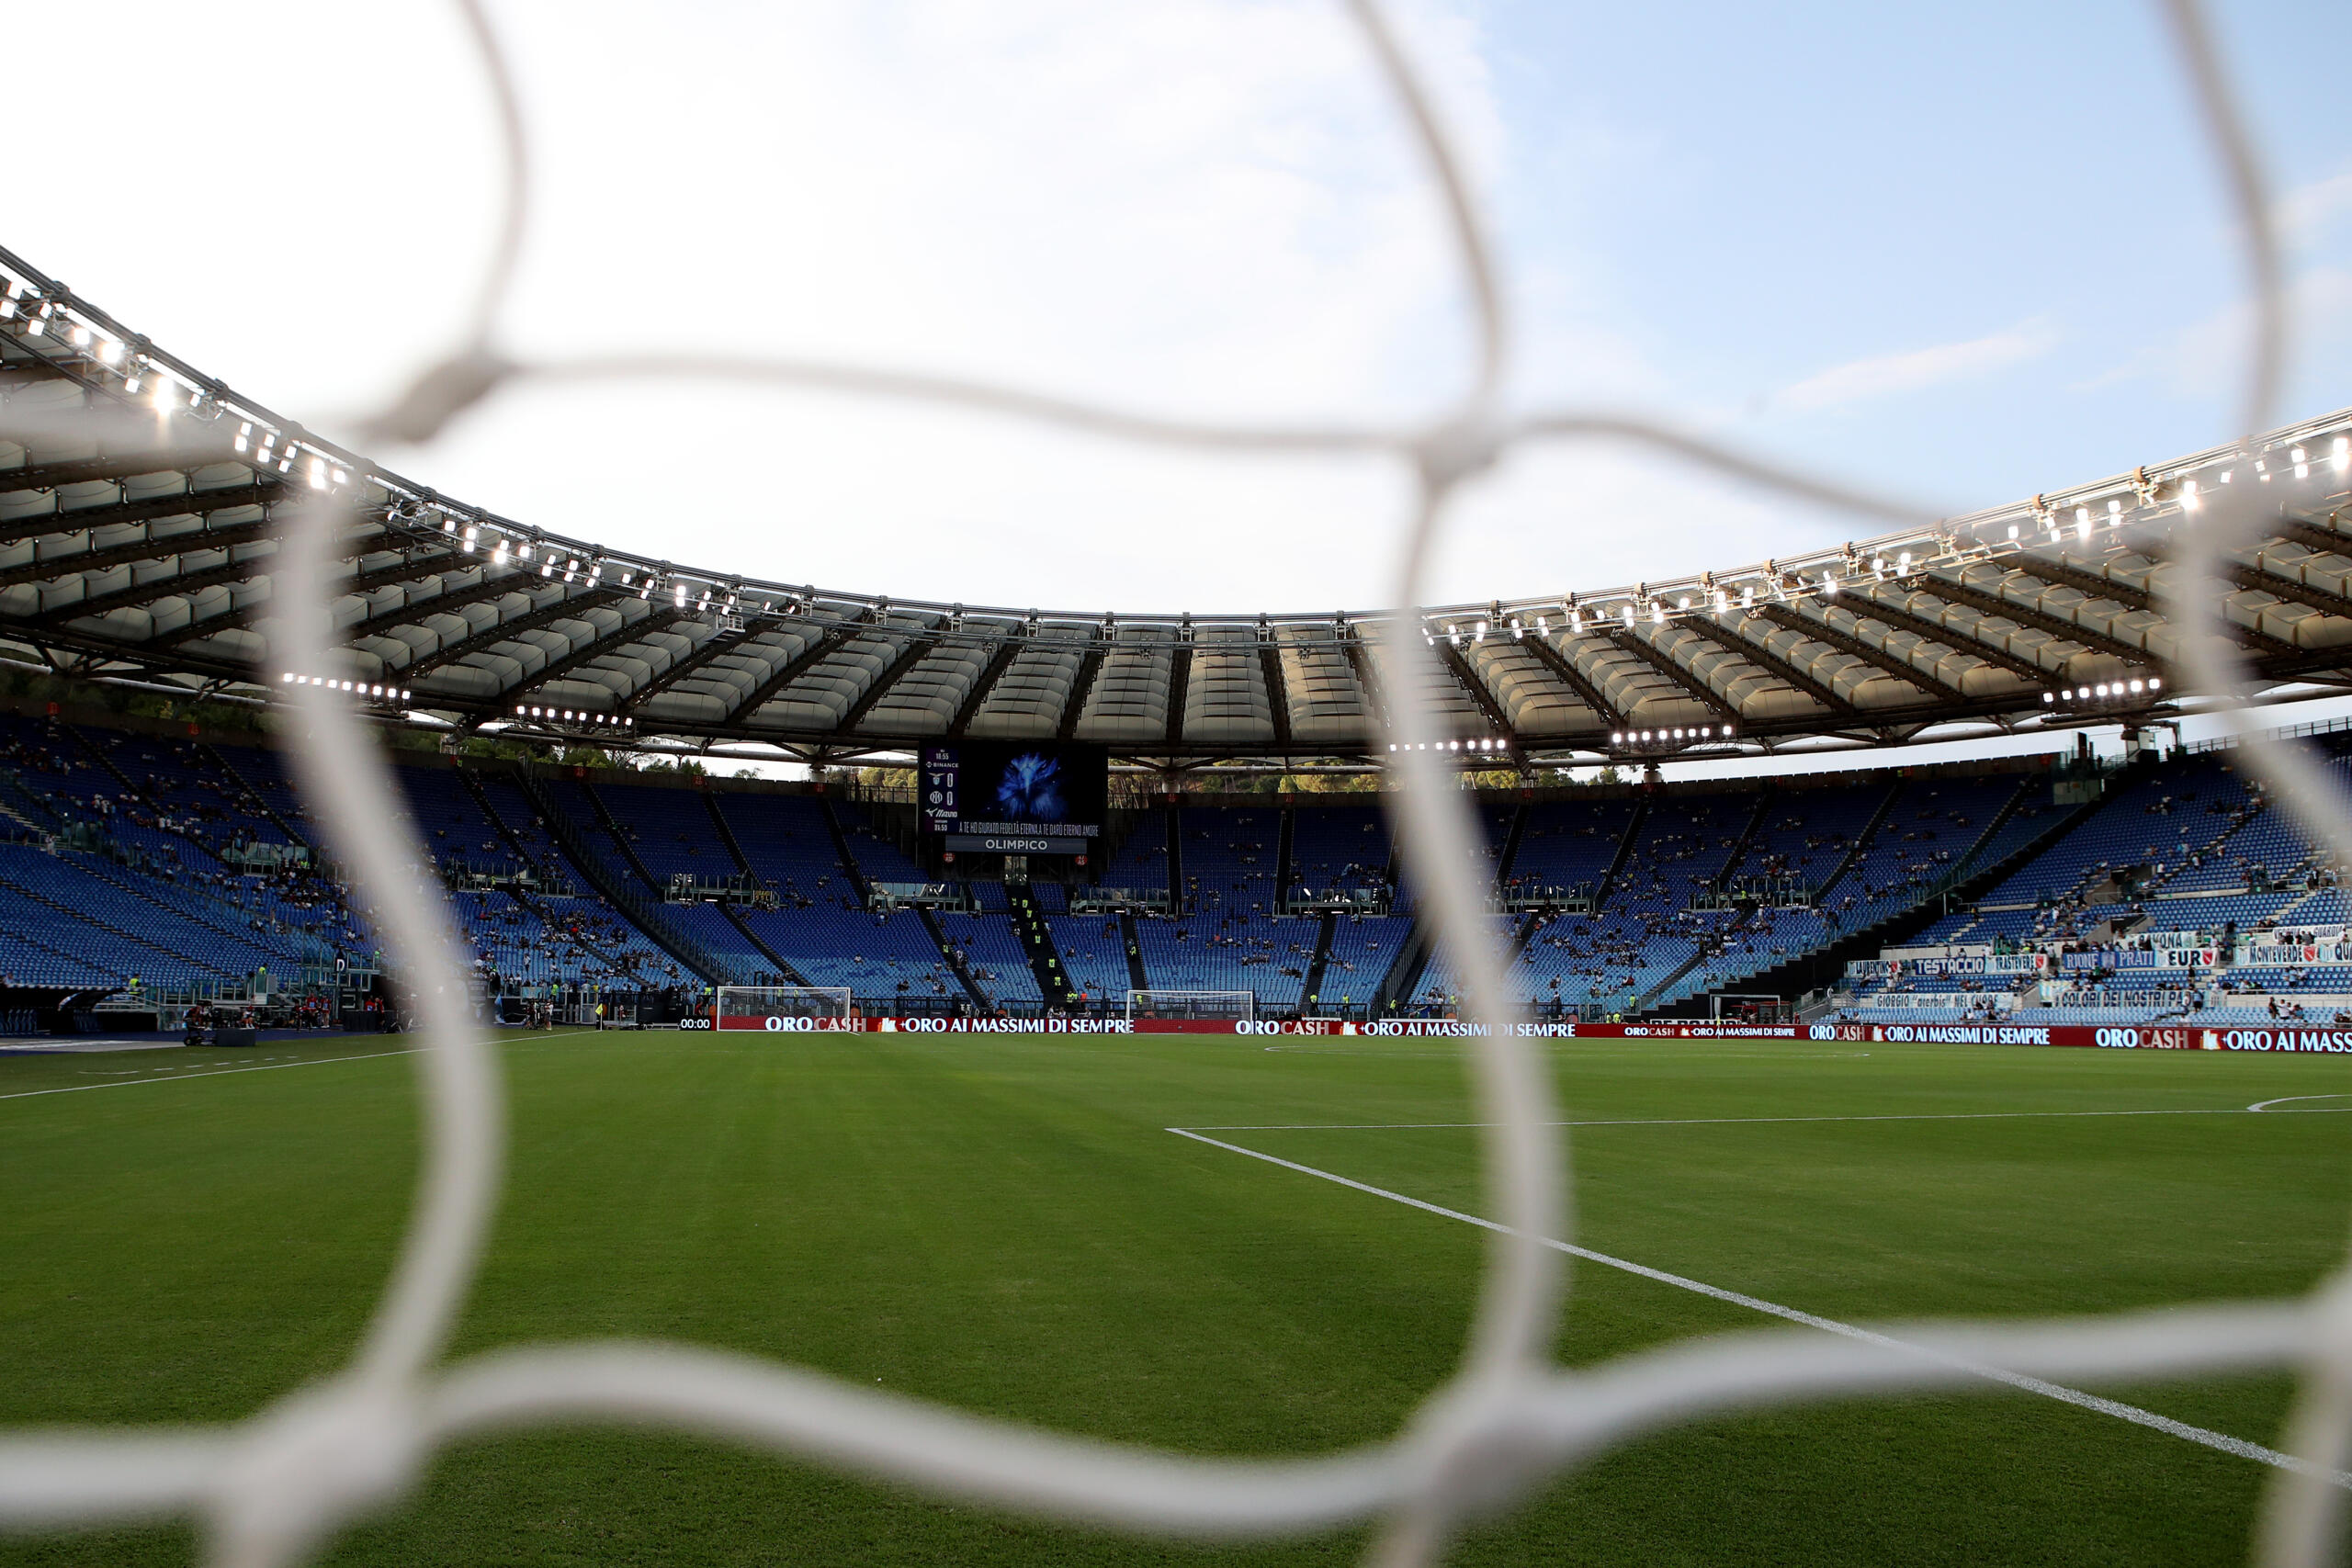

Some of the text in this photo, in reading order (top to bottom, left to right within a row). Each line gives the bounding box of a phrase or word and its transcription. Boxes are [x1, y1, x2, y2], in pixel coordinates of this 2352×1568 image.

[946, 773, 954, 788] 0
[946, 791, 954, 807] 0
[958, 821, 963, 833] A
[964, 821, 969, 833] TE
[985, 839, 1048, 851] OLIMPICO
[2066, 951, 2154, 969] RIONE PRATI
[2168, 950, 2202, 966] EUR
[2249, 945, 2302, 964] MONTEVERDE
[336, 958, 345, 972] D
[1916, 958, 1984, 975] TESTACCIO
[1877, 994, 1910, 1008] GIORGIO
[1954, 994, 1968, 1008] NEL
[2062, 991, 2101, 1008] COLORI
[2103, 991, 2121, 1008] DEI
[2123, 991, 2165, 1008] NOSTRI
[680, 1018, 710, 1030] 00:00
[764, 1016, 867, 1032] OROCASH
[905, 1017, 1135, 1034] ORO AI MASSIMI DI SEMPRE
[1235, 1020, 1329, 1035] OROCASH
[1364, 1021, 1403, 1036] ORO
[1406, 1022, 1421, 1037] AI
[1425, 1022, 1492, 1037] MASSIMI
[1517, 1023, 1576, 1038] SEMPRE
[1624, 1026, 1675, 1036] OROCASH
[1692, 1027, 1795, 1037] ORO AI MASSIMI DI SEMPRE
[1809, 1025, 1866, 1042] OROCASH
[1887, 1026, 2051, 1045] ORO AI MASSIMI DI SEMPRE
[2095, 1027, 2189, 1049] OROCASH
[2226, 1030, 2273, 1051] ORO
[2275, 1031, 2296, 1052] AI
